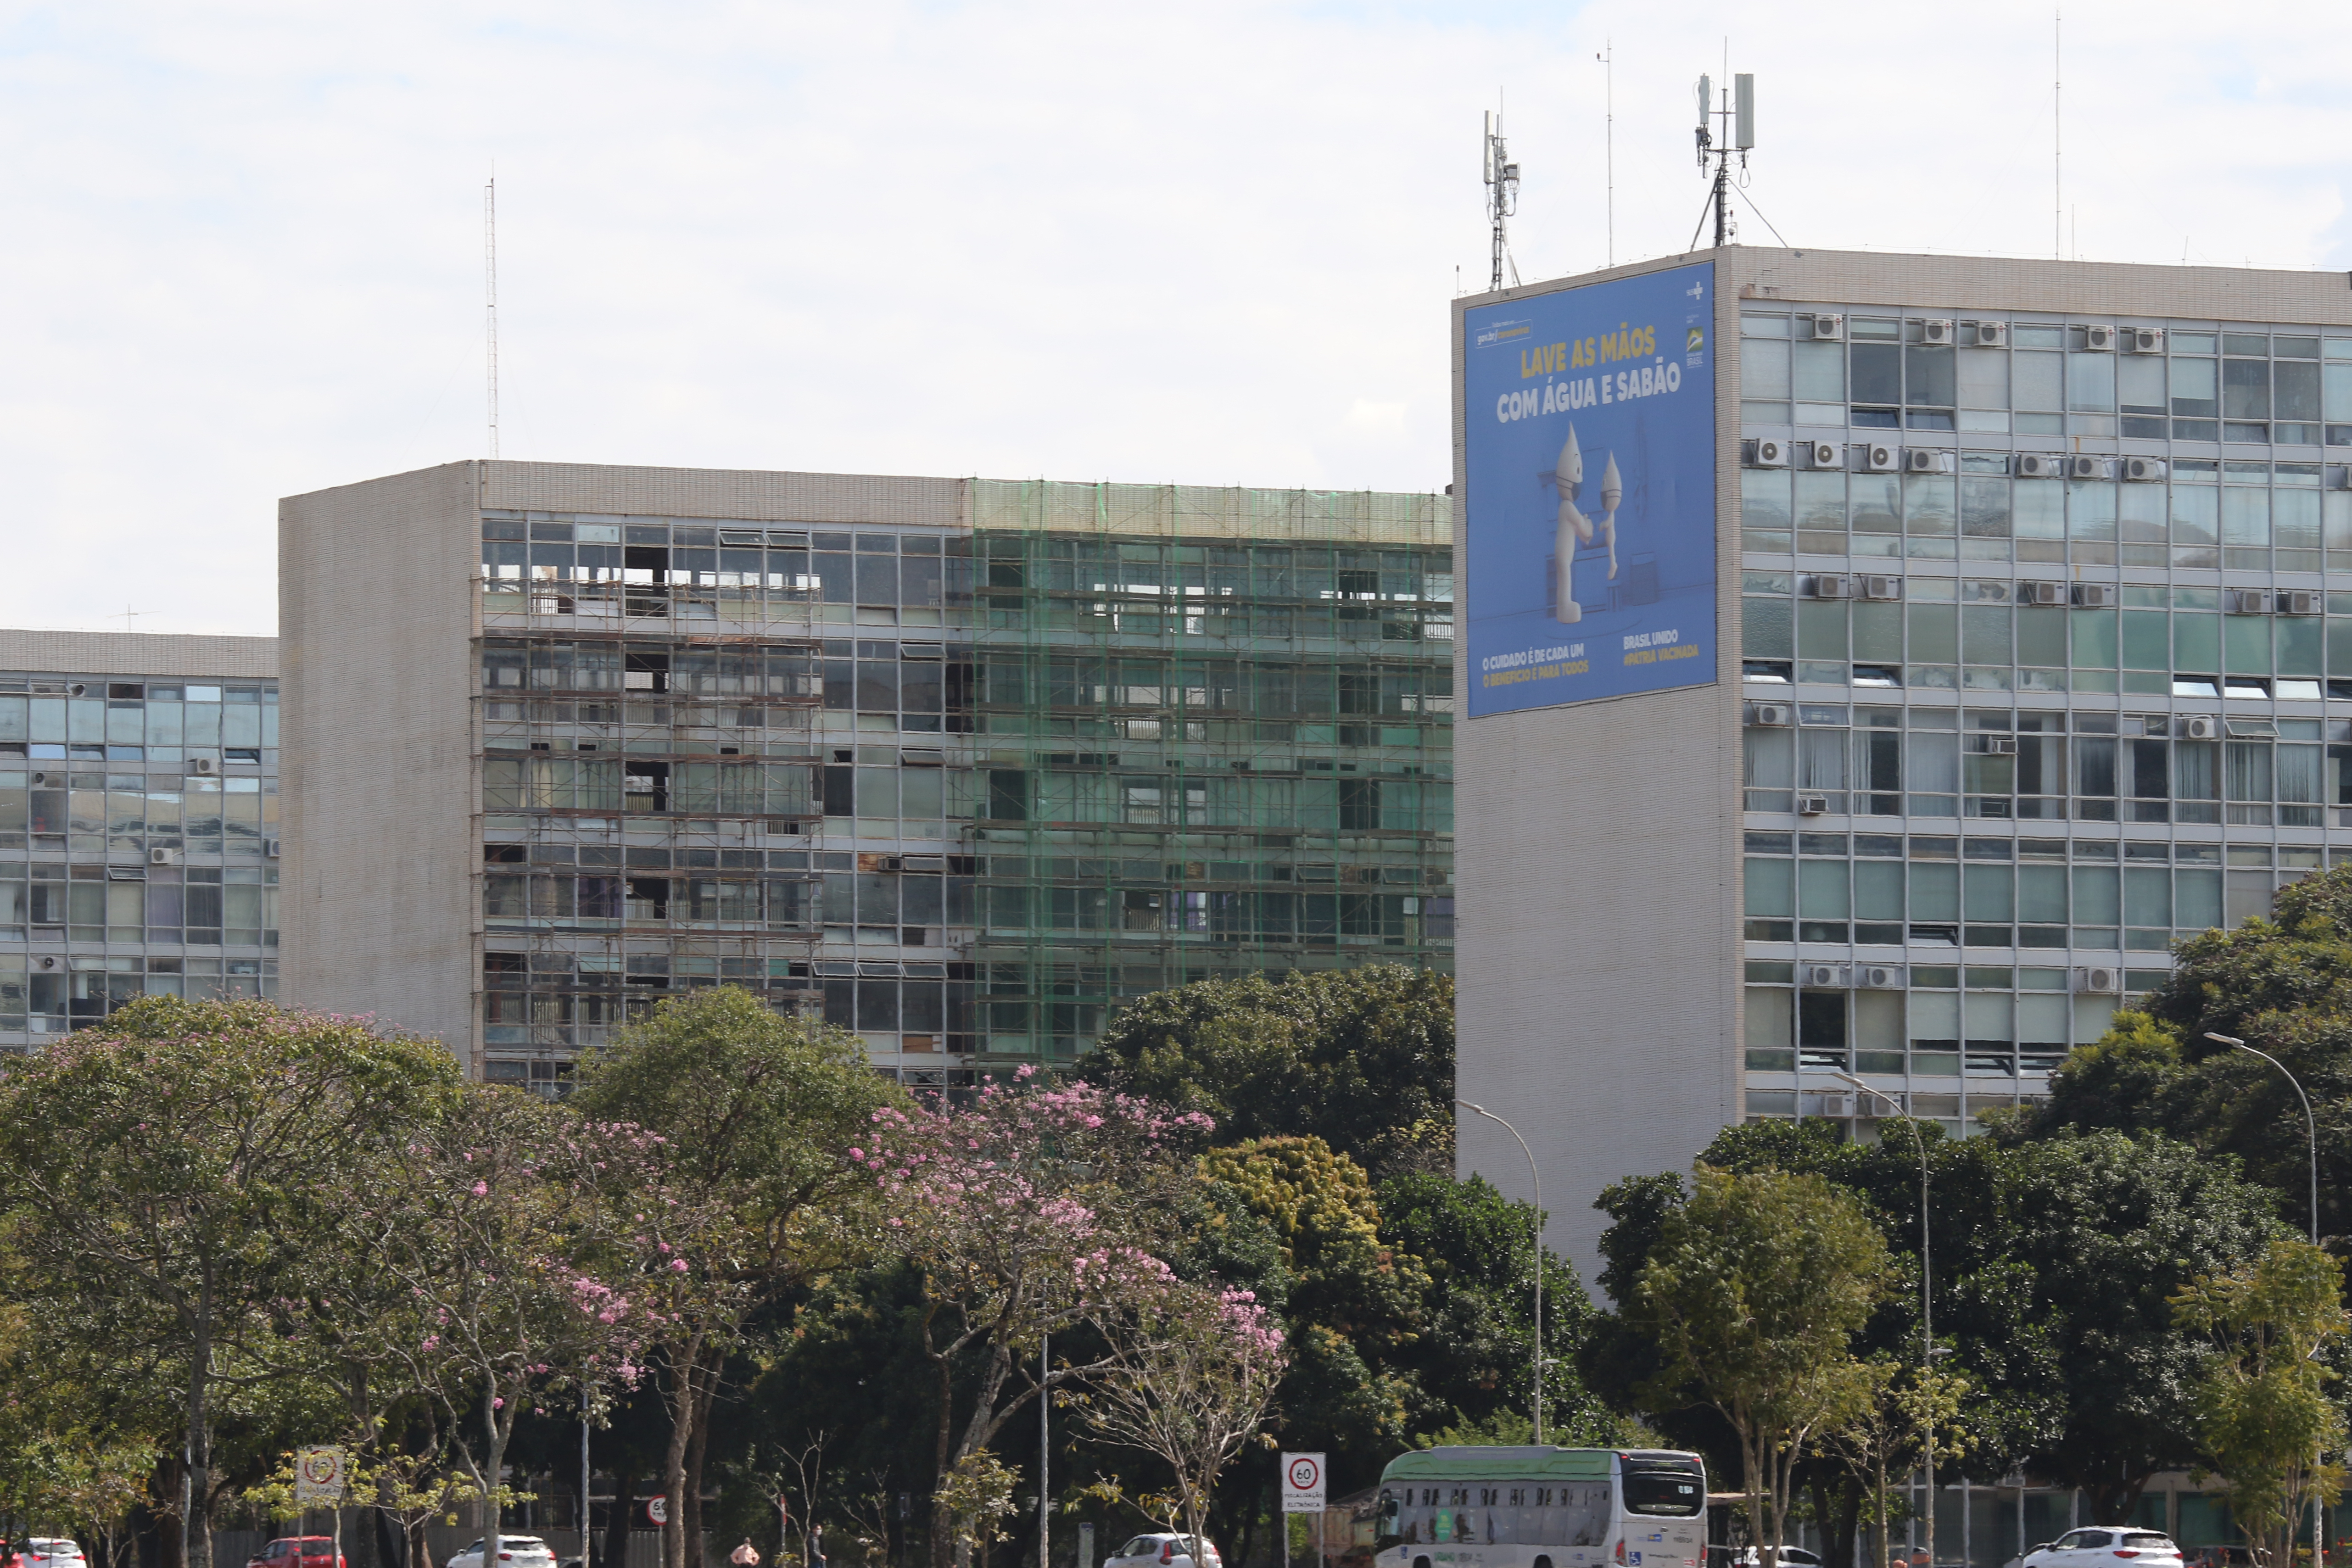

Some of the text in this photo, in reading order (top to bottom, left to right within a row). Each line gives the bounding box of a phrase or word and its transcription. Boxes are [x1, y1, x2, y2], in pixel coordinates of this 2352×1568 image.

[1521, 322, 1656, 379] LAVE AS MÃOS
[1687, 356, 1703, 366] BRASIL
[1497, 357, 1681, 423] COM ÁGUA E SABÃO
[1624, 629, 1678, 650] BRASIL UNIDO
[1483, 643, 1584, 670] O CUIDADO É DE CADA UM
[1624, 644, 1699, 666] #PÁTRIA VACINADA
[1483, 659, 1589, 688] O BENEFÍCIO É PARA TODOS
[1297, 1468, 1310, 1479] 60
